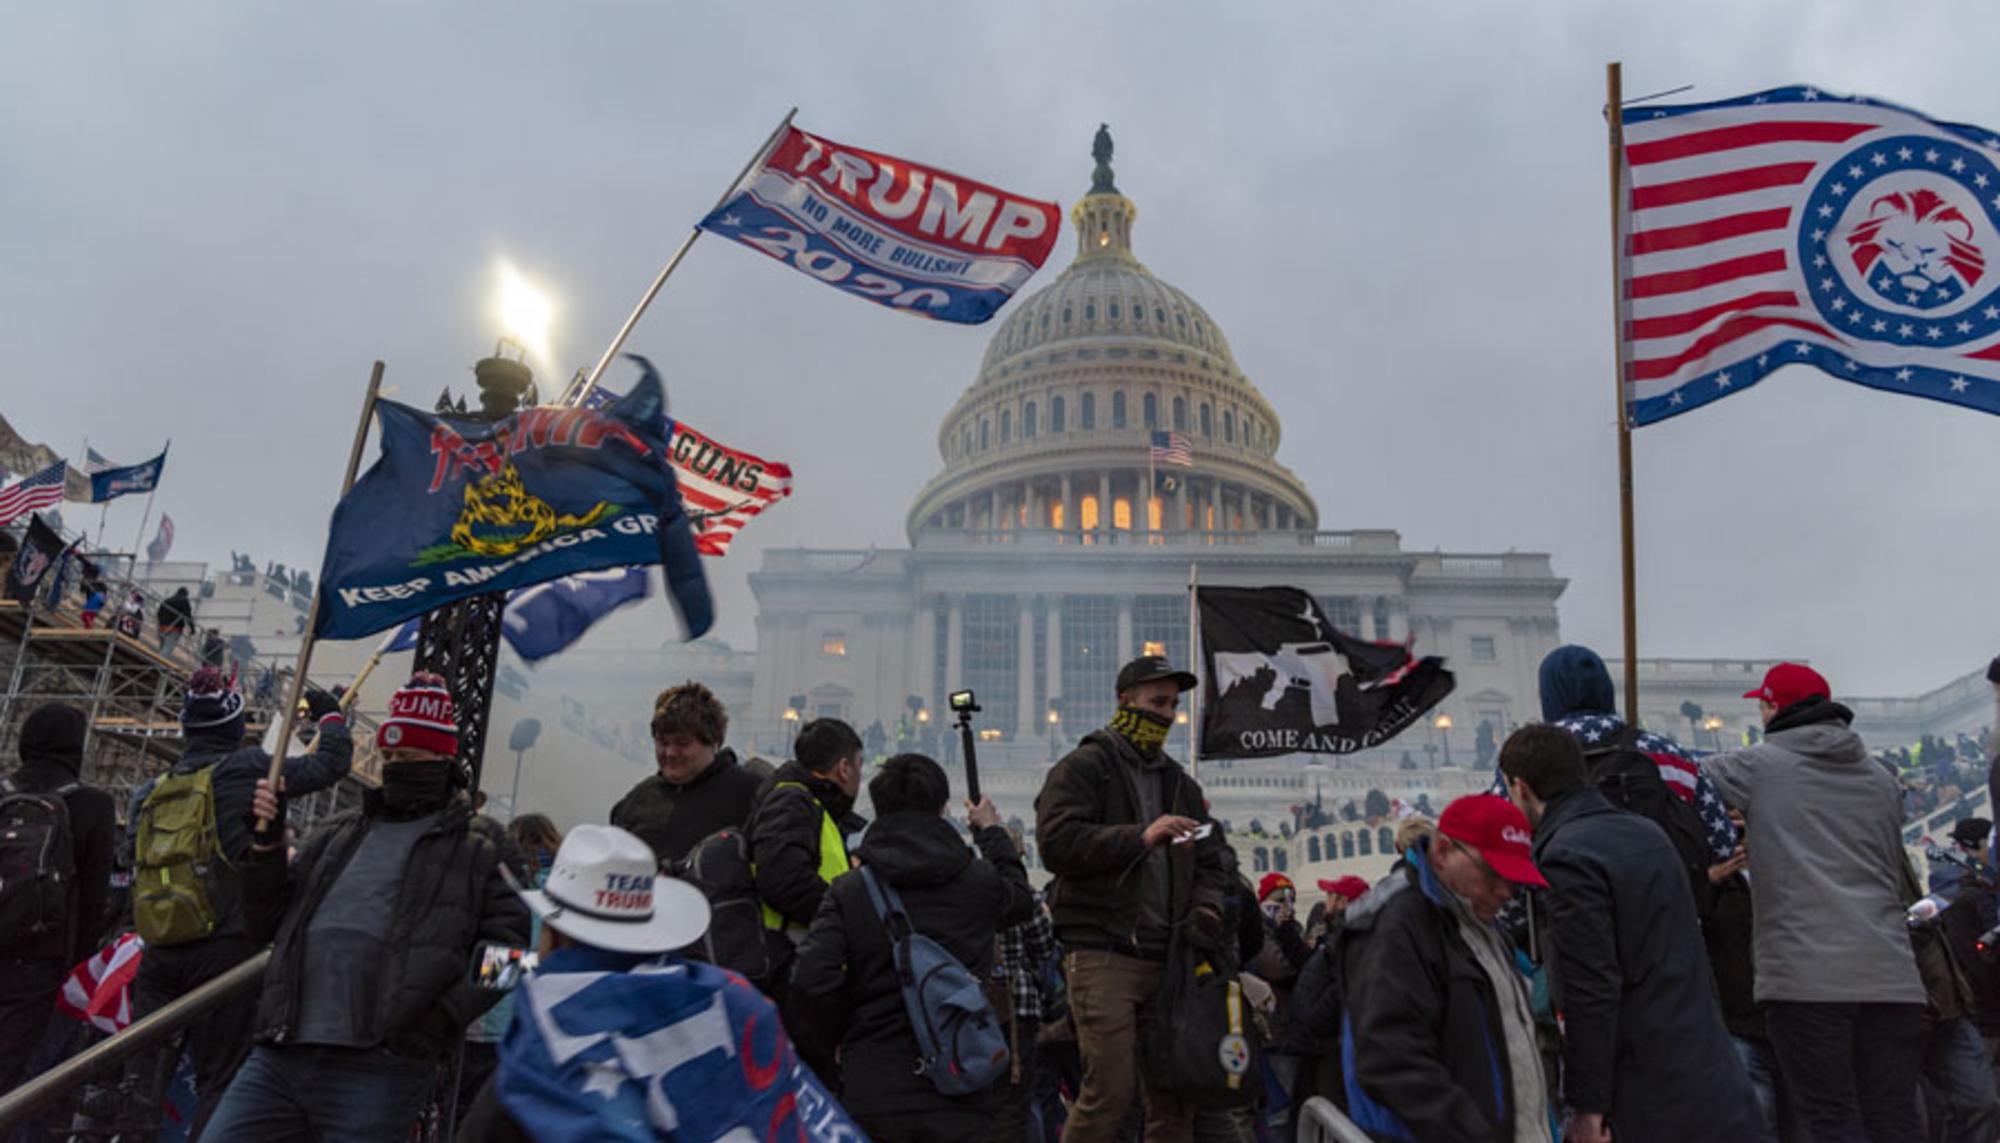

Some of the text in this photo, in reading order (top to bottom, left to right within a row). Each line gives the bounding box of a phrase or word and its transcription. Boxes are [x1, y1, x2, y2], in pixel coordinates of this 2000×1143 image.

[795, 133, 1048, 251] TRUMP
[802, 195, 828, 224] NO
[832, 217, 886, 255] MORE
[739, 226, 951, 311] 2020
[672, 431, 765, 492] GUNS
[338, 577, 433, 608] KEEP
[1239, 729, 1299, 750] COME
[1301, 733, 1357, 752] AND
